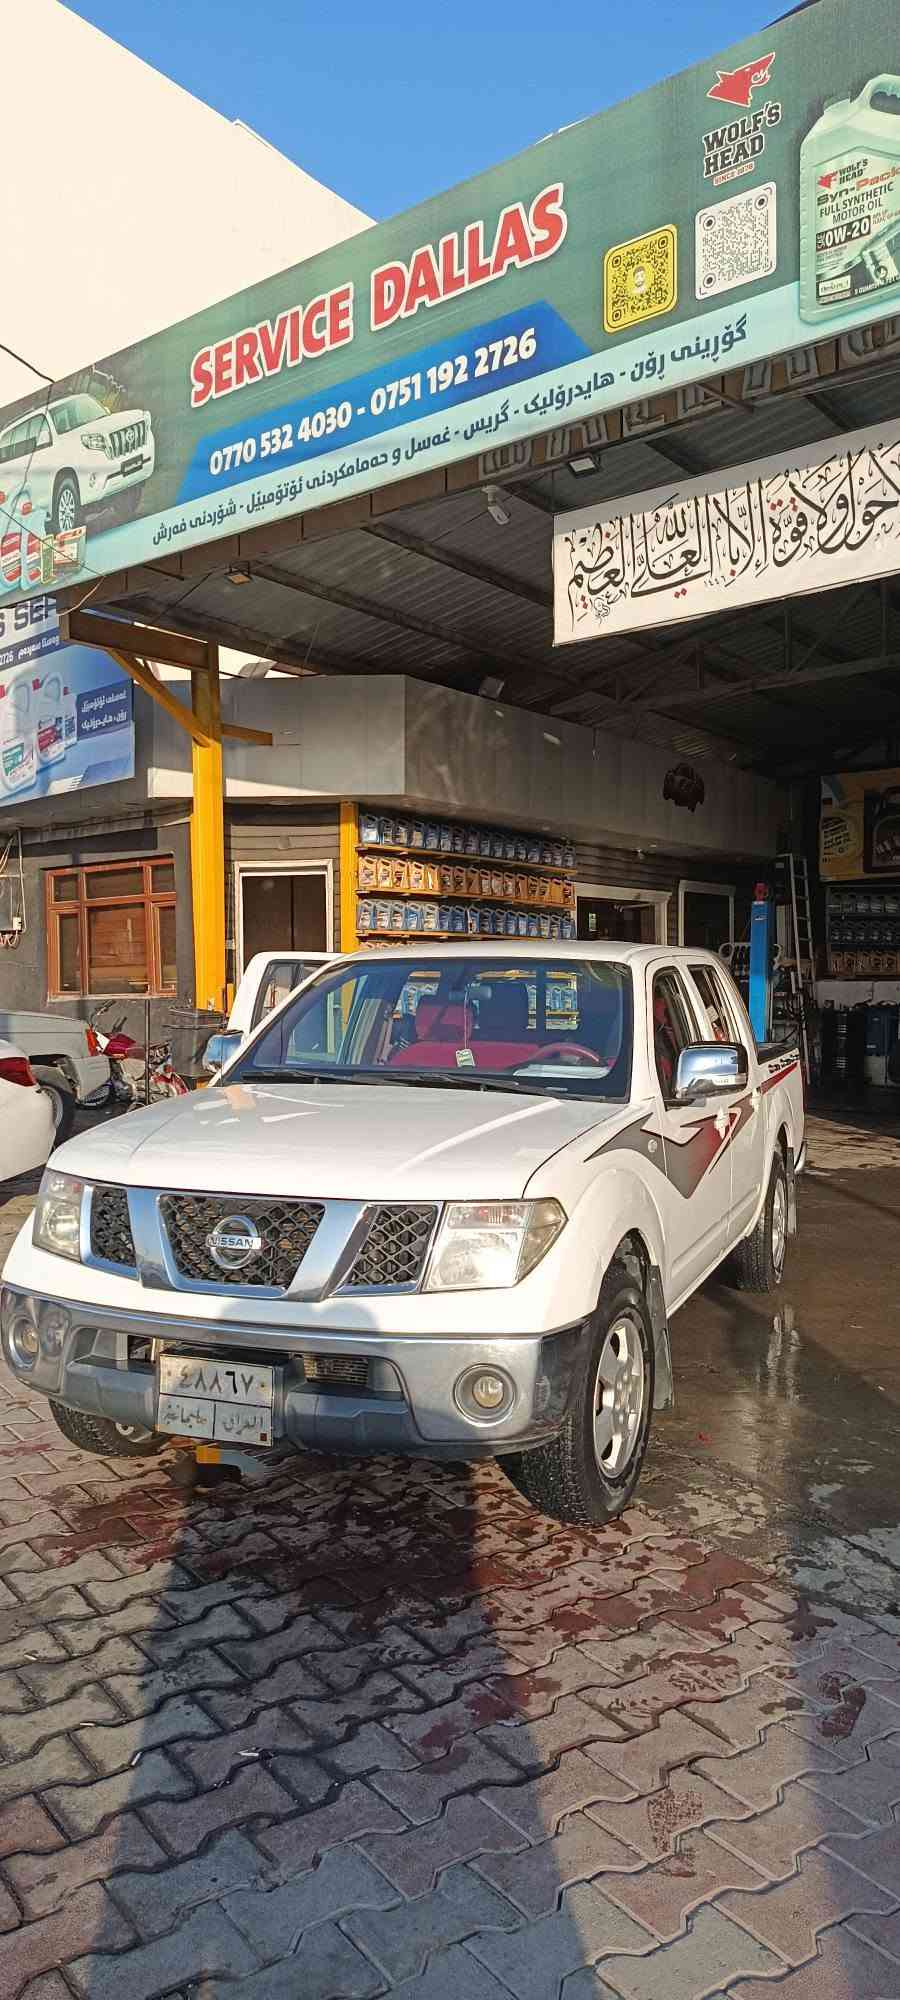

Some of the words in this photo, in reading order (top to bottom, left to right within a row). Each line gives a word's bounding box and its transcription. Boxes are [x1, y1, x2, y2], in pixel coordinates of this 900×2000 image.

[702, 101, 782, 154] WOLF'S
[704, 132, 764, 177] HEAD
[839, 159, 868, 176] WOLF'S
[839, 168, 864, 184] HEAD
[820, 202, 840, 218] FULL
[842, 181, 894, 210] SYNTHETIC
[833, 204, 865, 225] MOTOR
[867, 198, 883, 211] OIL
[825, 218, 869, 247] 0W-20
[190, 283, 353, 408] SERVICE
[370, 183, 567, 331] DALLAS
[209, 437, 256, 475] 0770
[260, 423, 293, 458] 532
[298, 401, 352, 442] 4030
[370, 372, 422, 416] 0751
[427, 354, 468, 391] 192
[474, 328, 537, 378] 2726
[392, 448, 401, 465] و
[207, 1236, 254, 1248] NISSAN
[178, 1365, 254, 1396] ٤٨٨٦٧
